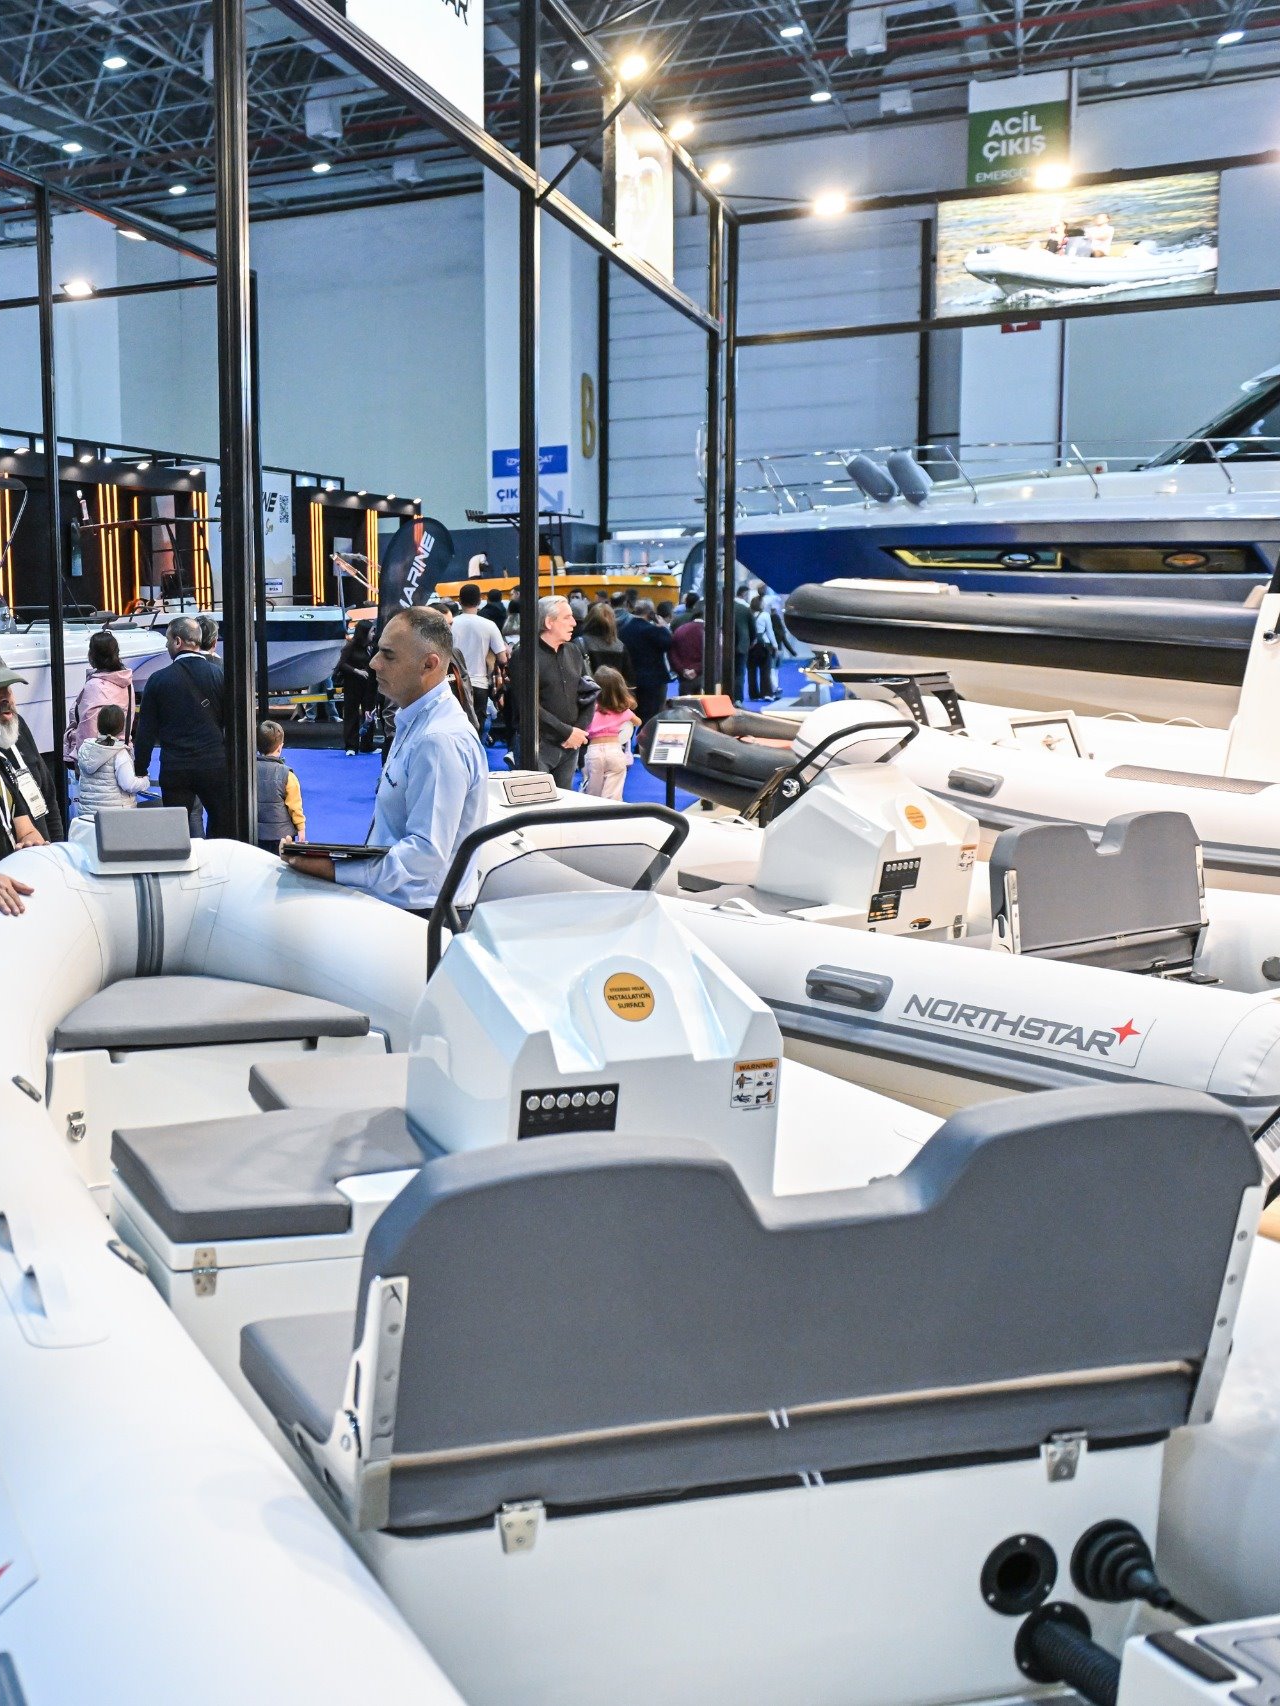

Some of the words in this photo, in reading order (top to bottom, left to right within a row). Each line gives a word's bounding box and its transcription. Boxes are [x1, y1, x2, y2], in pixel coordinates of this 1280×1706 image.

[987, 111, 1042, 138] ACİL
[982, 134, 1047, 163] ÇIKIŞ
[581, 372, 596, 460] B
[496, 488, 519, 503] ÇIK
[607, 993, 651, 1001] INSTALLATION
[903, 993, 1116, 1056] NORTHSTAR
[739, 1061, 774, 1071] WARNING
